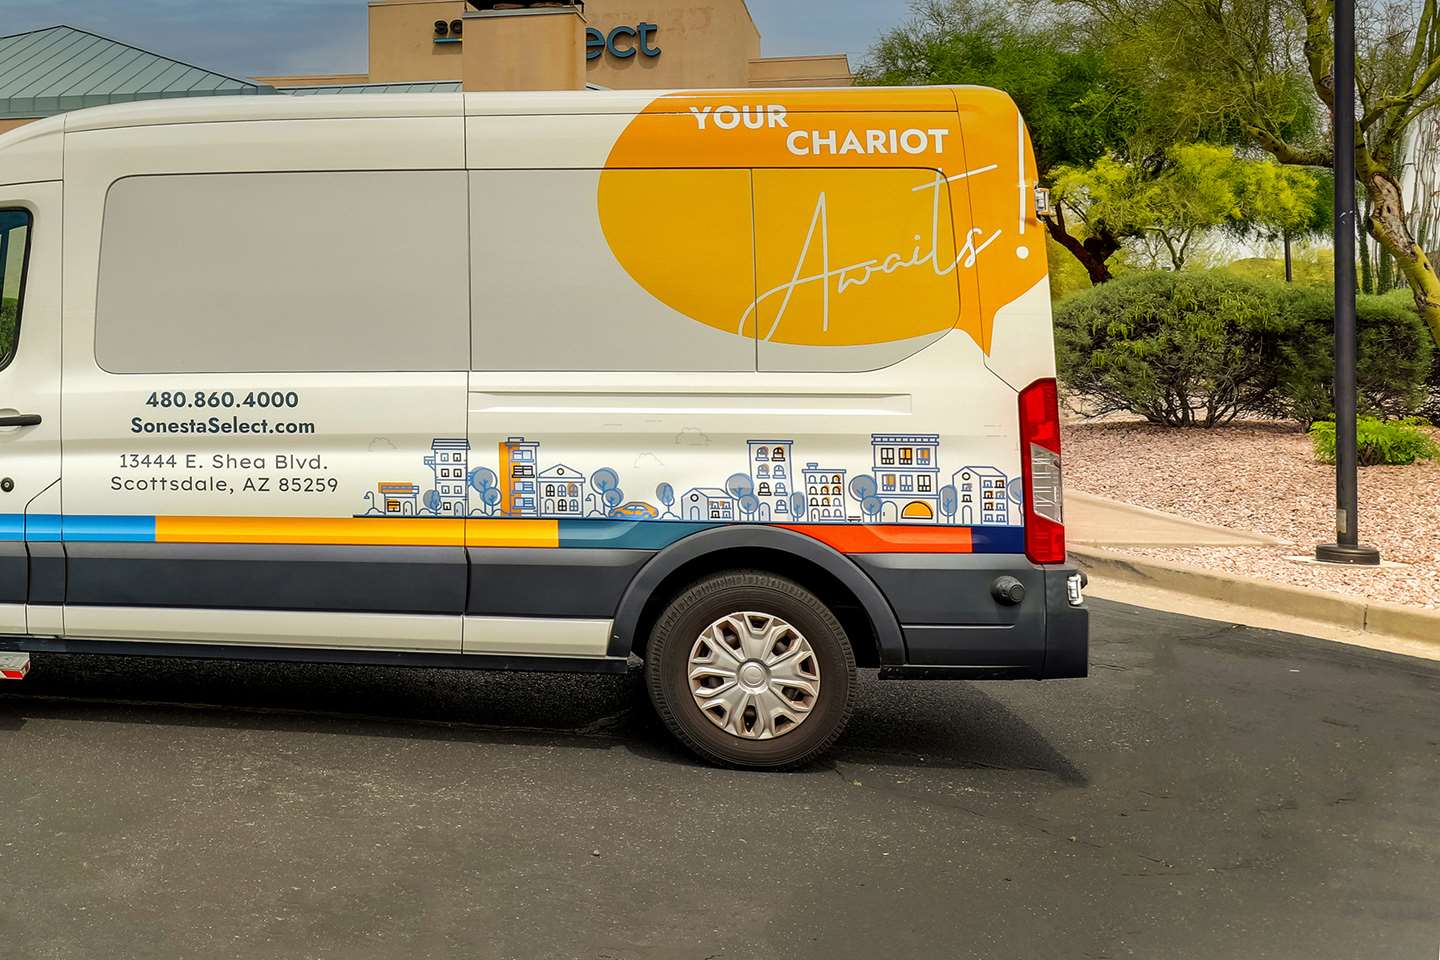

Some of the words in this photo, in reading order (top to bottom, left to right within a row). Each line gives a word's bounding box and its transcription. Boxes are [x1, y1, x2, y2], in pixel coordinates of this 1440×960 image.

[586, 22, 661, 61] ect
[689, 104, 788, 130] YOUR
[786, 129, 948, 155] CHARIOT
[146, 391, 299, 408] 480.860.4000
[130, 416, 316, 434] SonestaSelect.com
[119, 454, 177, 468] 13444
[186, 454, 203, 468] E.
[212, 454, 266, 469] Shea
[275, 454, 328, 470] Blvd.
[110, 476, 235, 495] Scottsdale,
[243, 477, 270, 492] AZ
[278, 478, 339, 493] 85259
